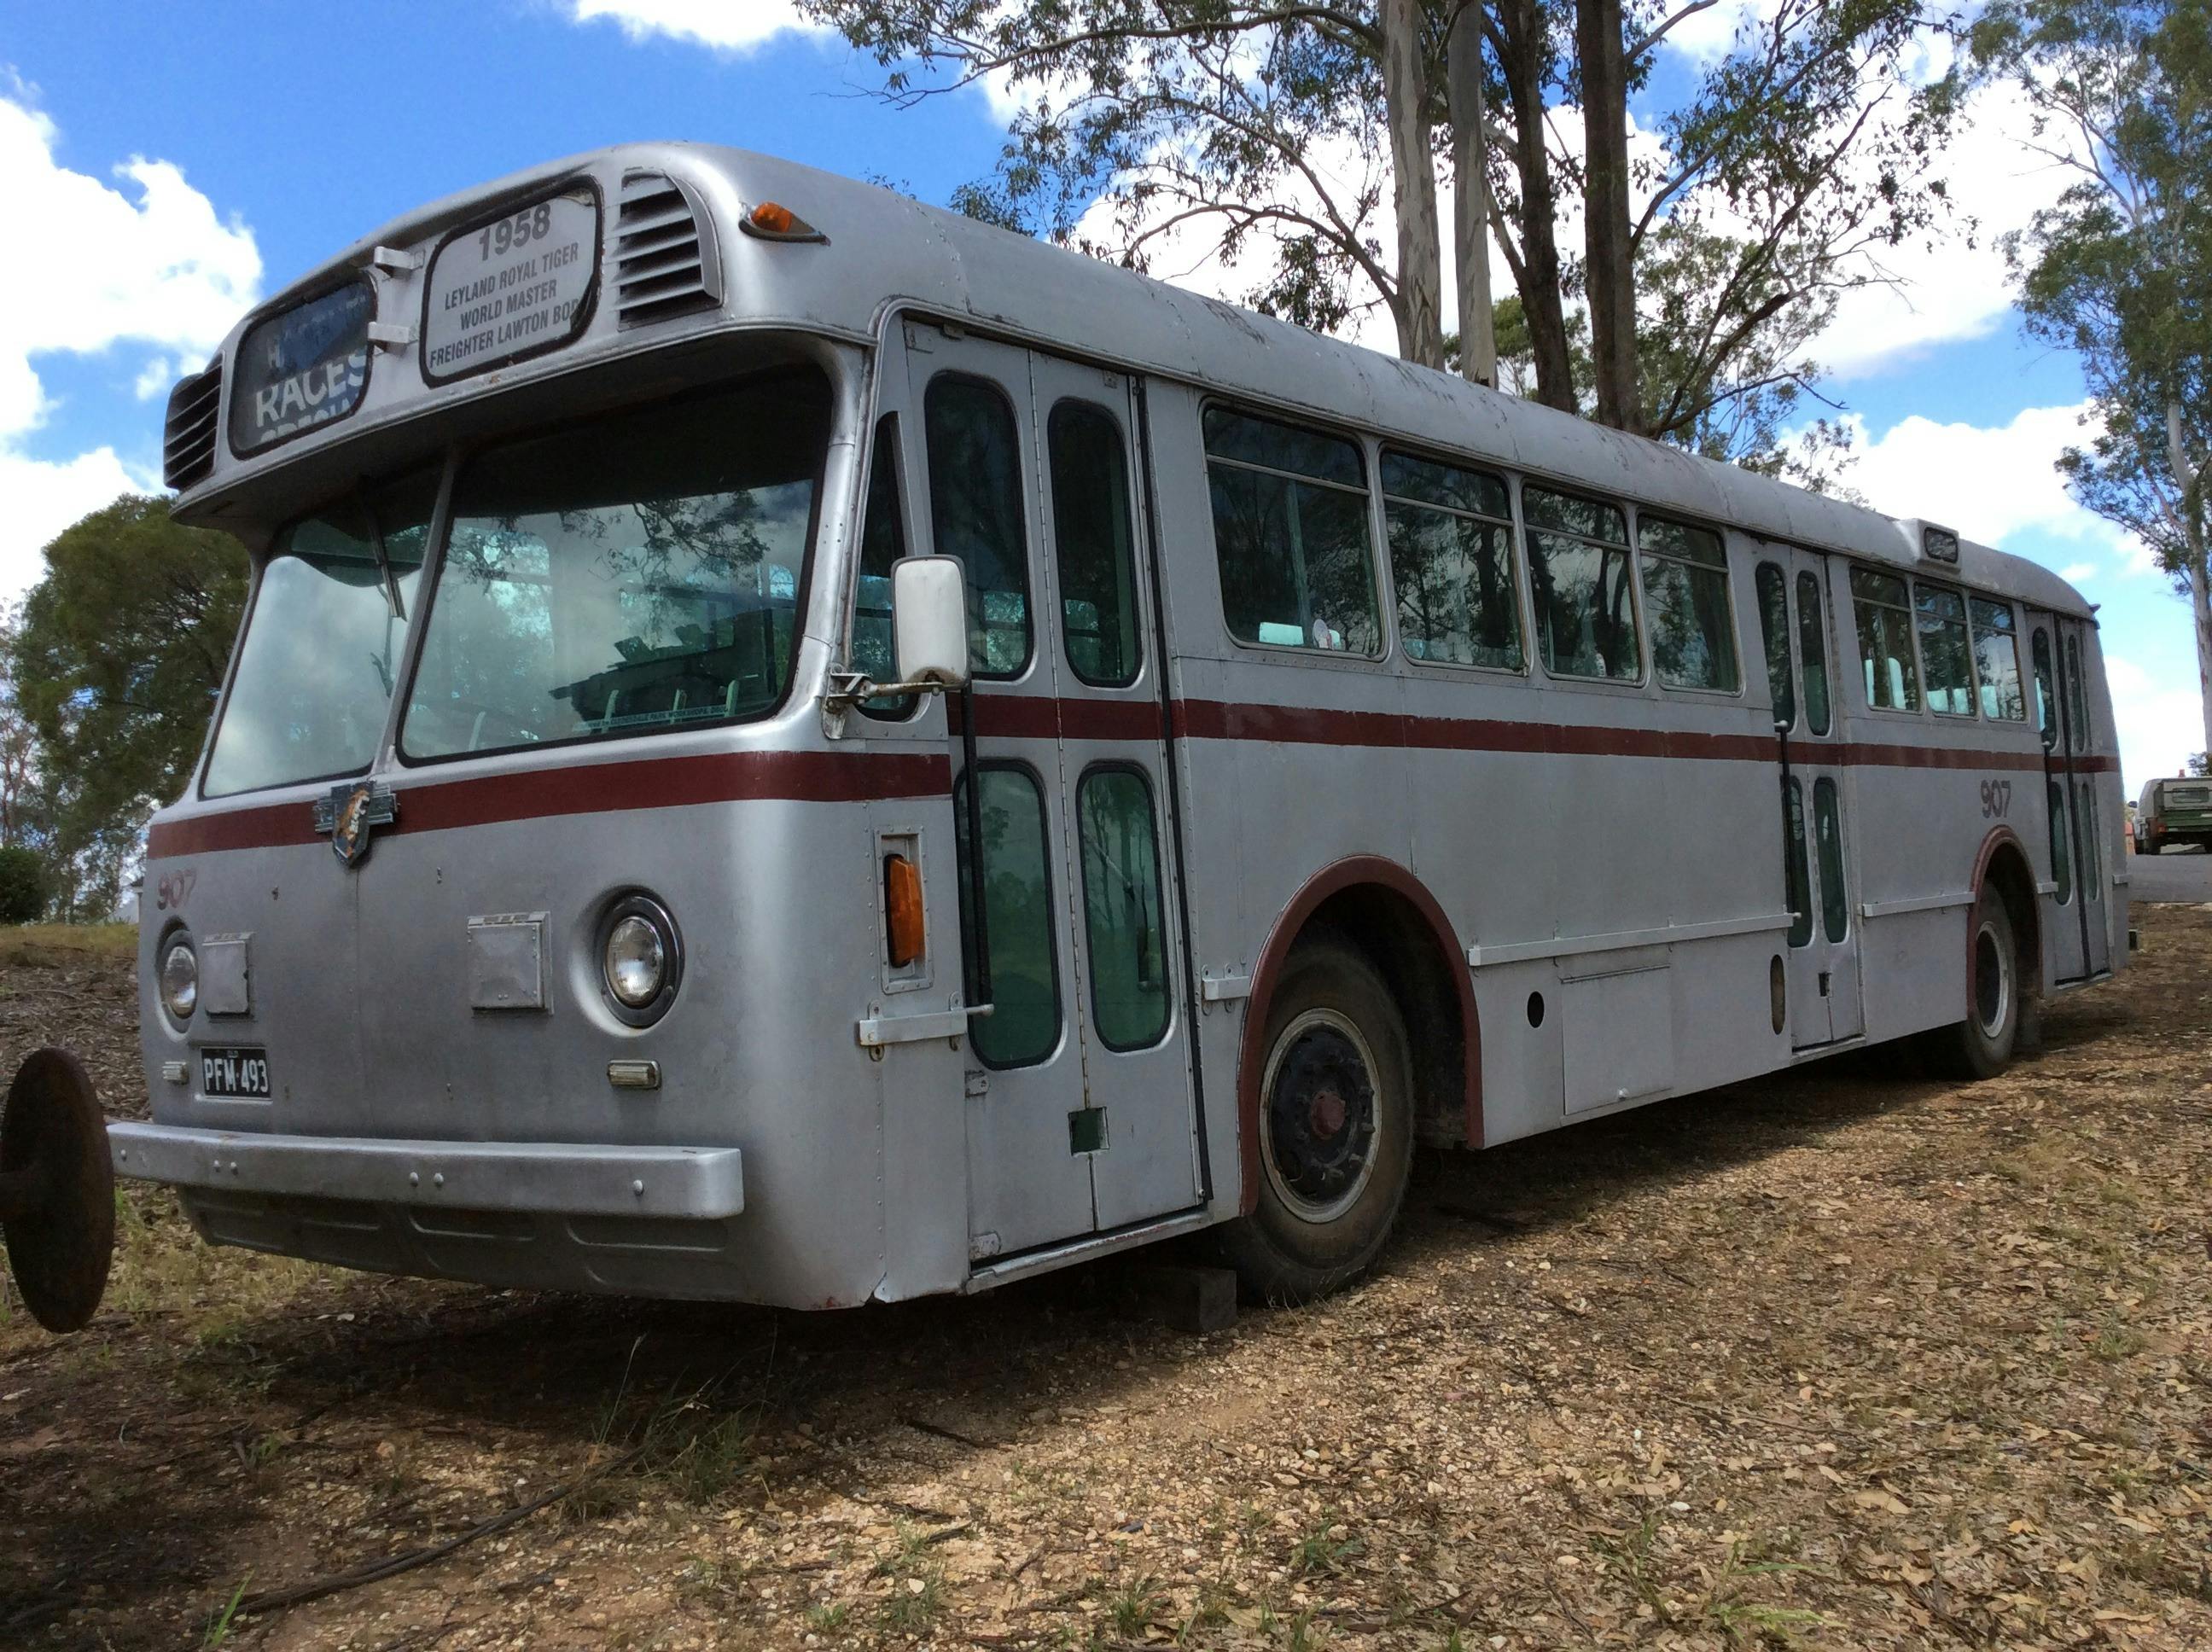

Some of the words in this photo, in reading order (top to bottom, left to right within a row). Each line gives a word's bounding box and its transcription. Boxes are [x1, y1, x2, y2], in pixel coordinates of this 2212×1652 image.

[479, 202, 551, 261] 1958
[445, 276, 496, 311] LEYLAND
[499, 259, 538, 289] ROYAL
[543, 242, 579, 273] TIGER
[460, 300, 503, 330] WORLD
[506, 279, 557, 314] MASTER
[429, 329, 493, 369] FREIGHTER
[498, 310, 549, 344] LAWTON
[256, 345, 367, 428] RACES
[1980, 779, 2011, 818] 907
